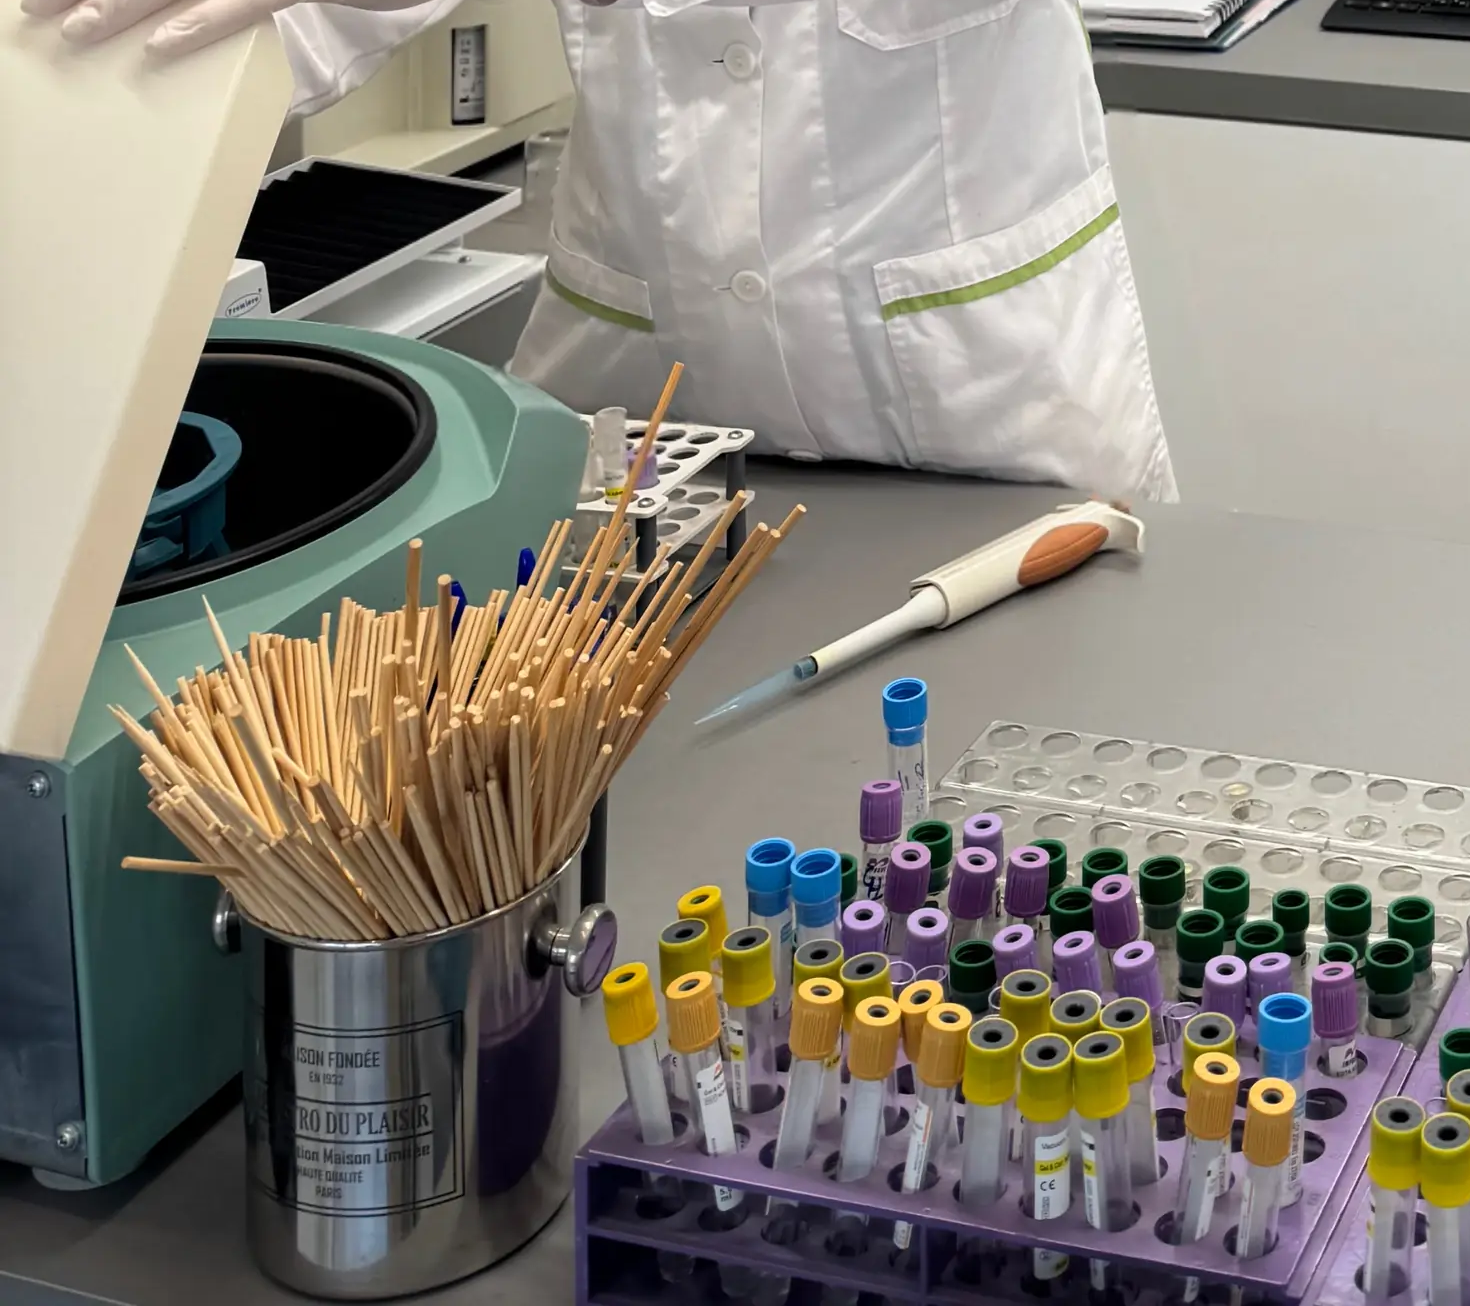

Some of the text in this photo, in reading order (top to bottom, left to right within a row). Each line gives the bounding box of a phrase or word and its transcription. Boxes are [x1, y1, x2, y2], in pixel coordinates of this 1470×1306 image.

[328, 1048, 381, 1069] FONDÉE
[309, 1073, 344, 1085] EN 1932
[326, 1110, 350, 1136] DU
[356, 1104, 430, 1136] PLAISIR
[323, 1147, 371, 1165] Maison
[325, 1170, 364, 1184] QUALITÉ
[315, 1186, 343, 1199] PARIS
